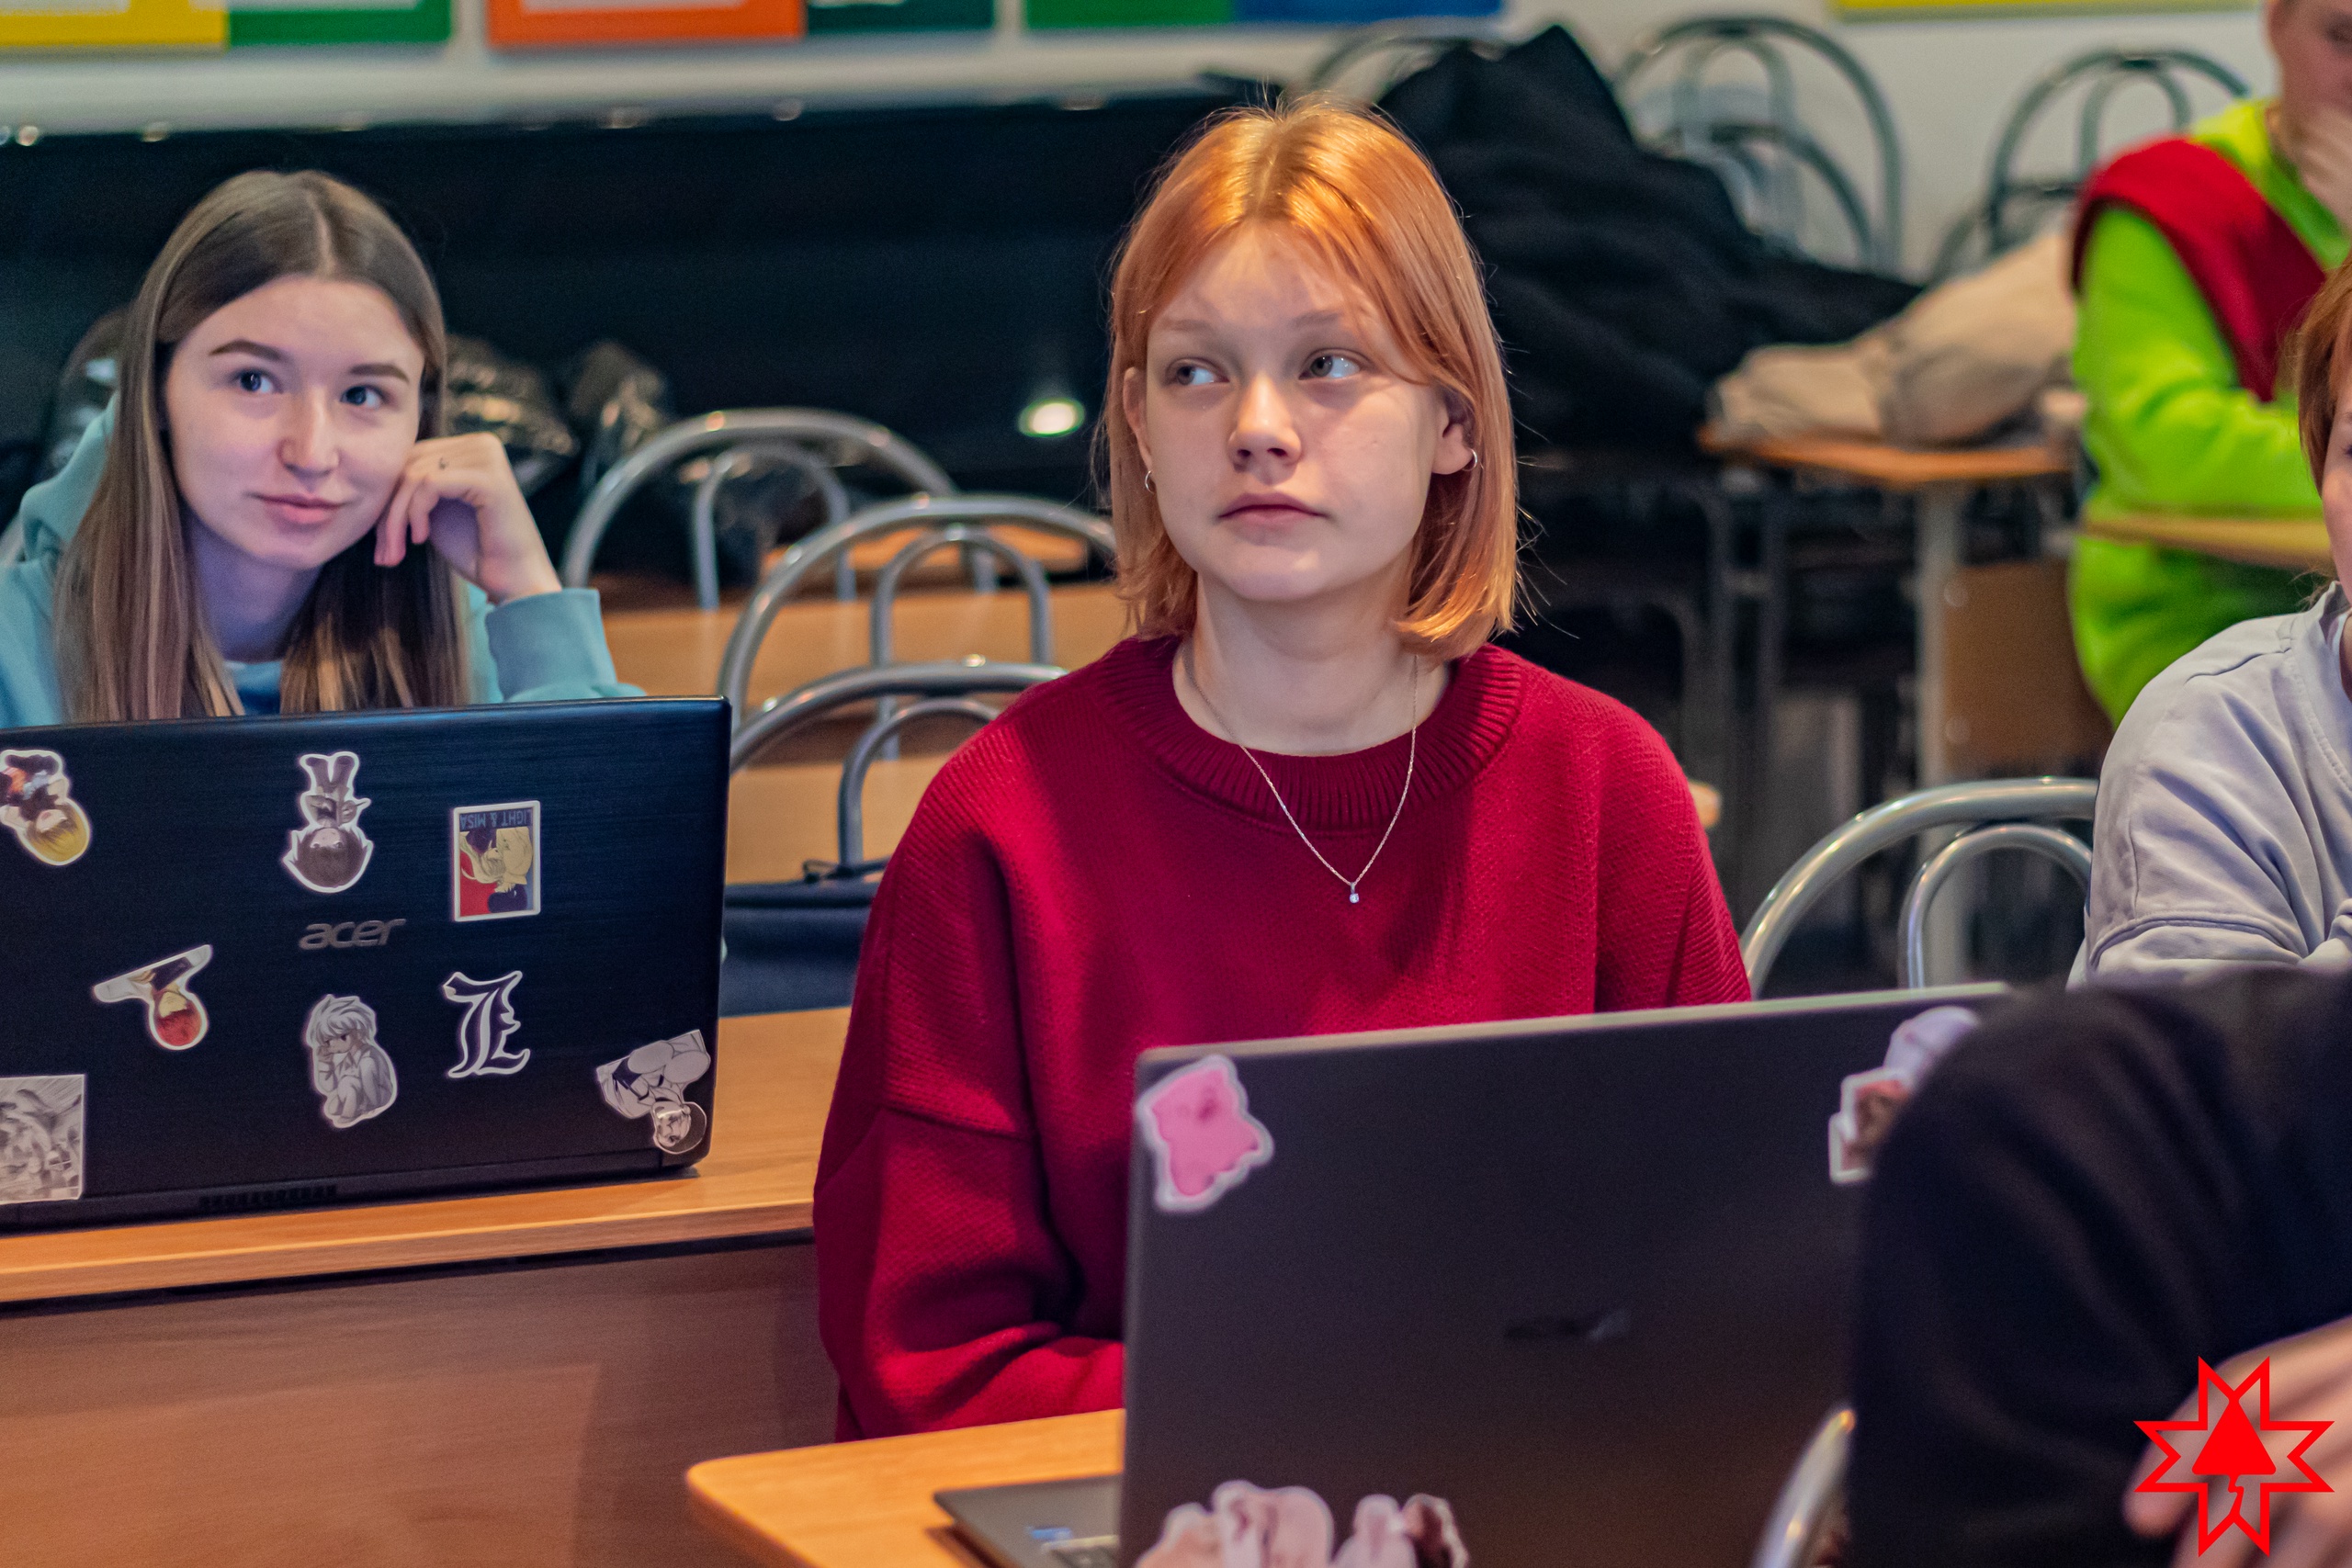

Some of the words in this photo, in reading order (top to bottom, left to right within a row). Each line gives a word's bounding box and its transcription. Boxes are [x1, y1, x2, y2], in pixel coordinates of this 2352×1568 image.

[460, 813, 486, 829] MISA
[501, 809, 532, 827] LIGHT
[299, 919, 406, 950] acer
